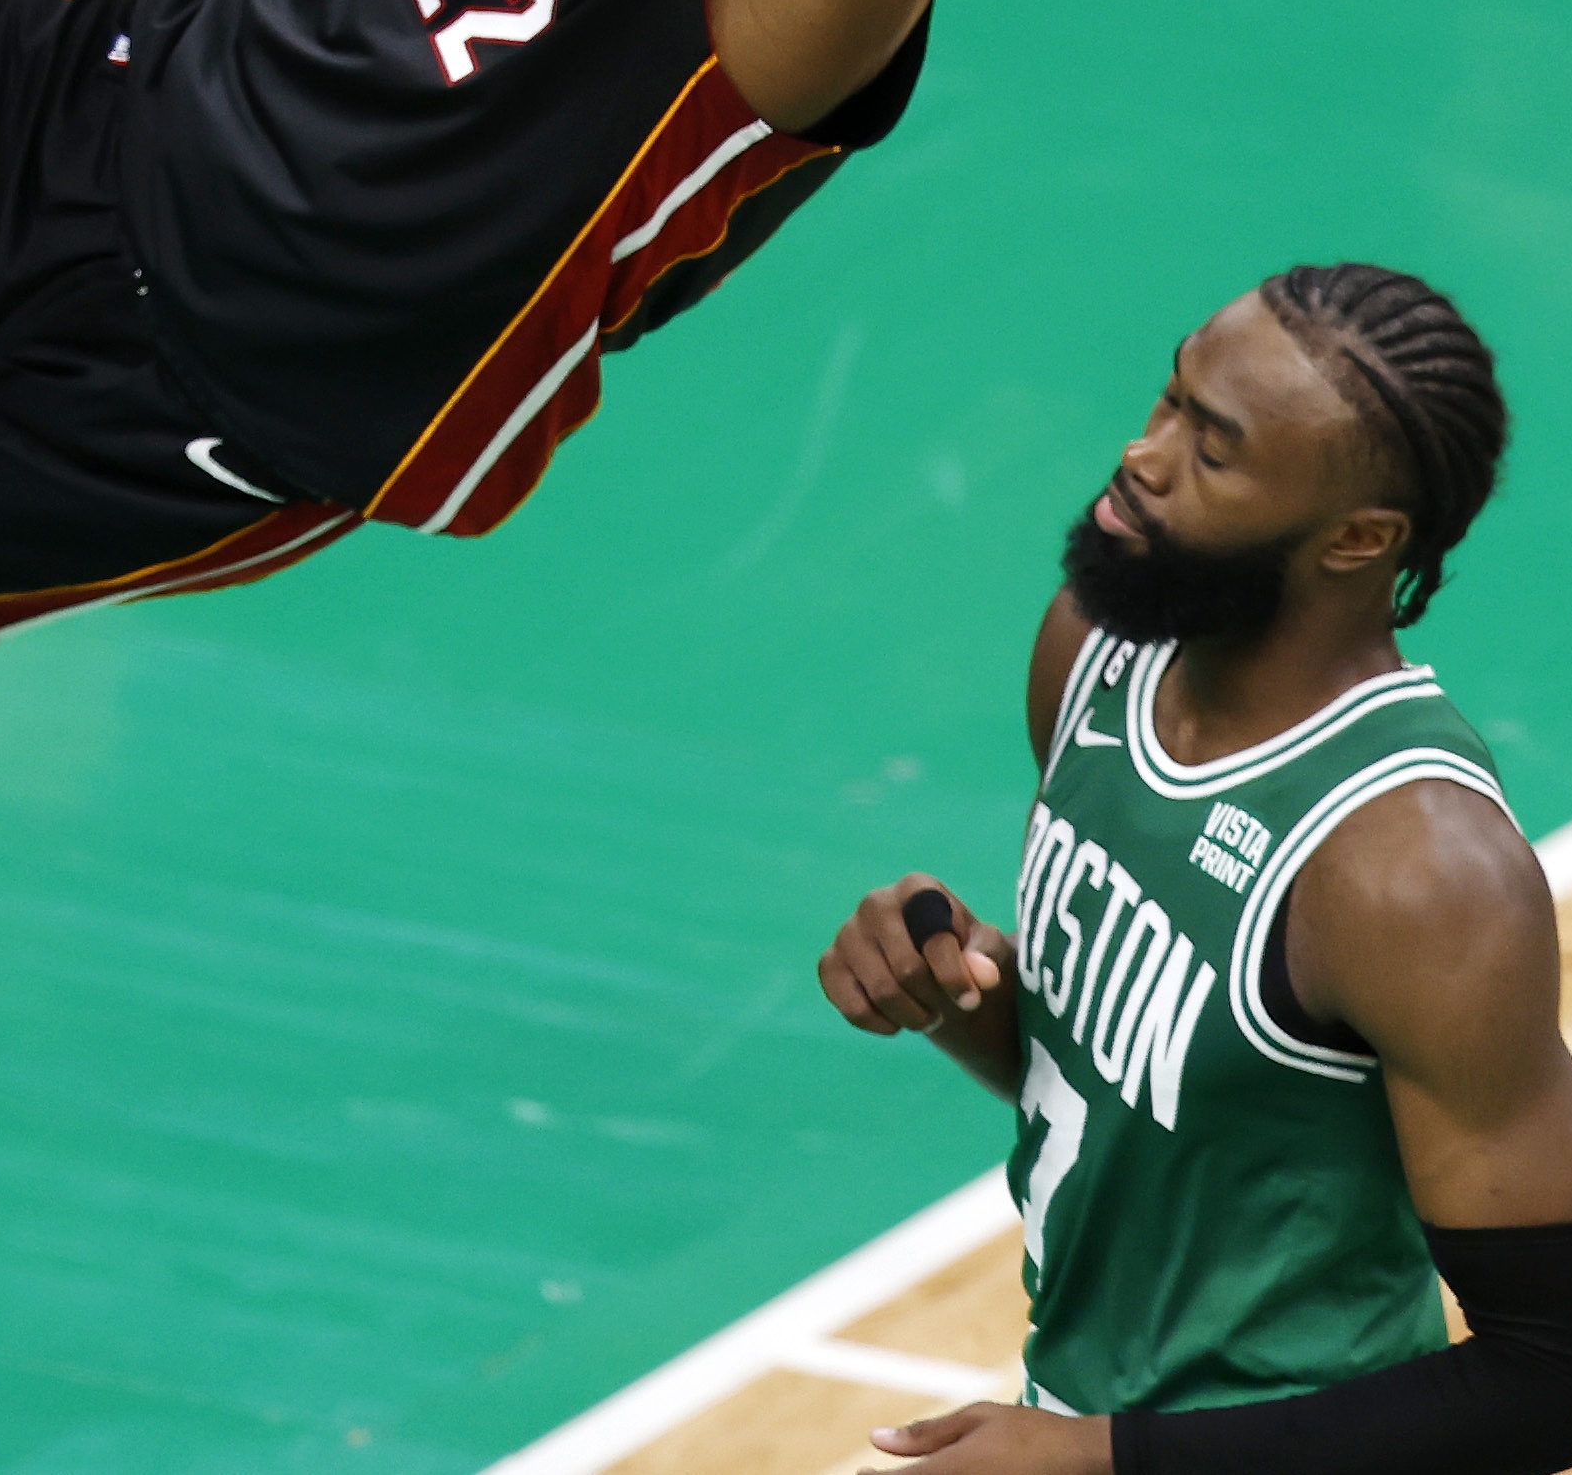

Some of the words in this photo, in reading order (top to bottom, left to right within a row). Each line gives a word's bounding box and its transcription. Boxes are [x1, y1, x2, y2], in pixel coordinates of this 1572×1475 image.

[1103, 639, 1137, 688] 6
[1188, 834, 1257, 895] PRINT
[1203, 801, 1272, 869] VISTA
[1020, 1036, 1089, 1292] 7
